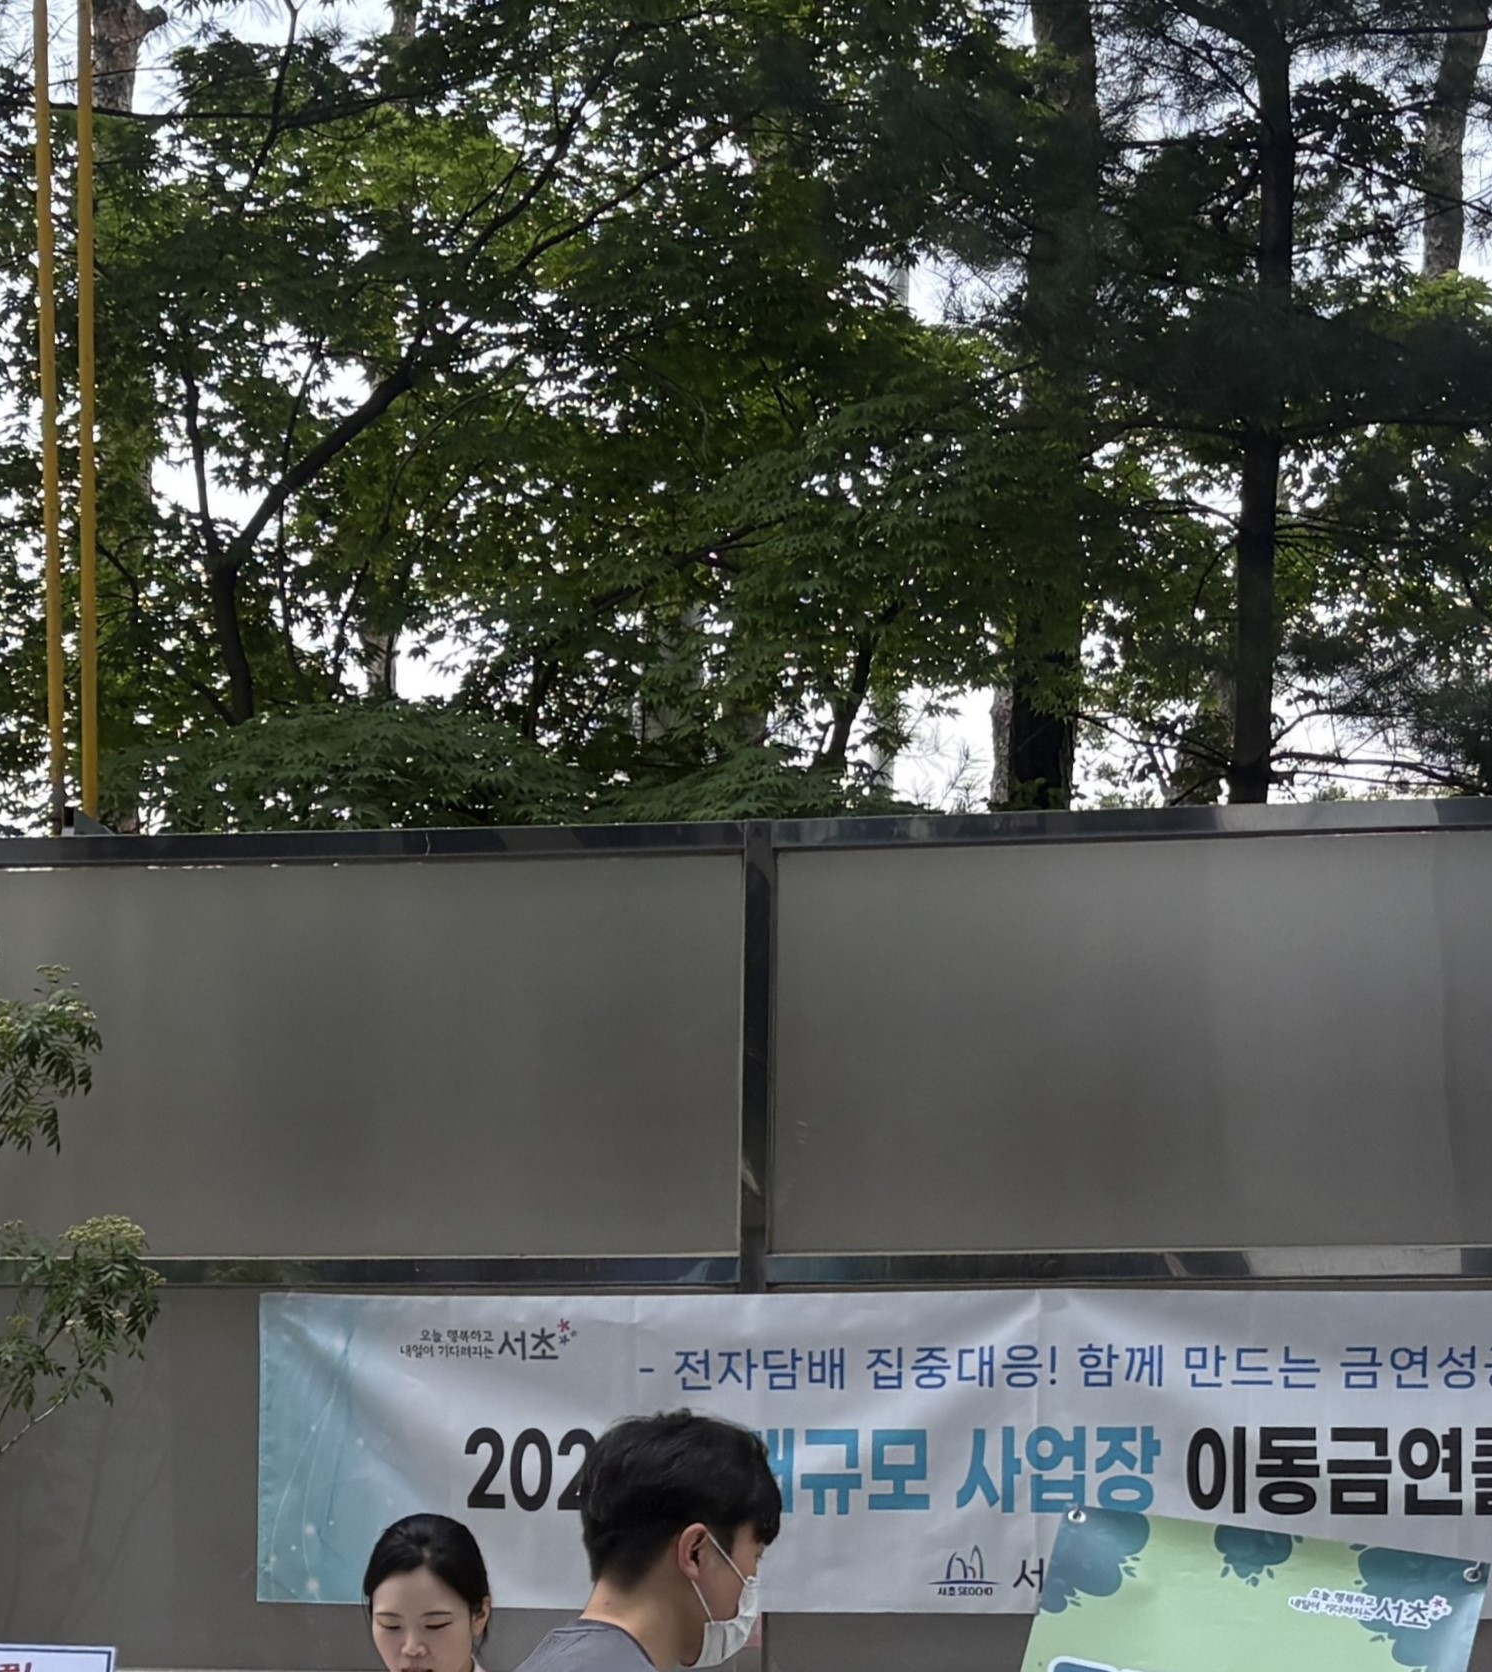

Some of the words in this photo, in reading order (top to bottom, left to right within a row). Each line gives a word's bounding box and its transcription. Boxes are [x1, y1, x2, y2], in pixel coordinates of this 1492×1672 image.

[420, 1329, 441, 1342] 오늘
[498, 1327, 559, 1360] 서초
[674, 1346, 846, 1391] 전자담배
[865, 1346, 1059, 1390] 집중대응!
[1077, 1345, 1164, 1390] 함께
[1184, 1345, 1322, 1390] 만드는
[956, 1426, 1160, 1514] 사업장
[1310, 1590, 1330, 1601] 오늘
[1376, 1600, 1428, 1627] 서초
